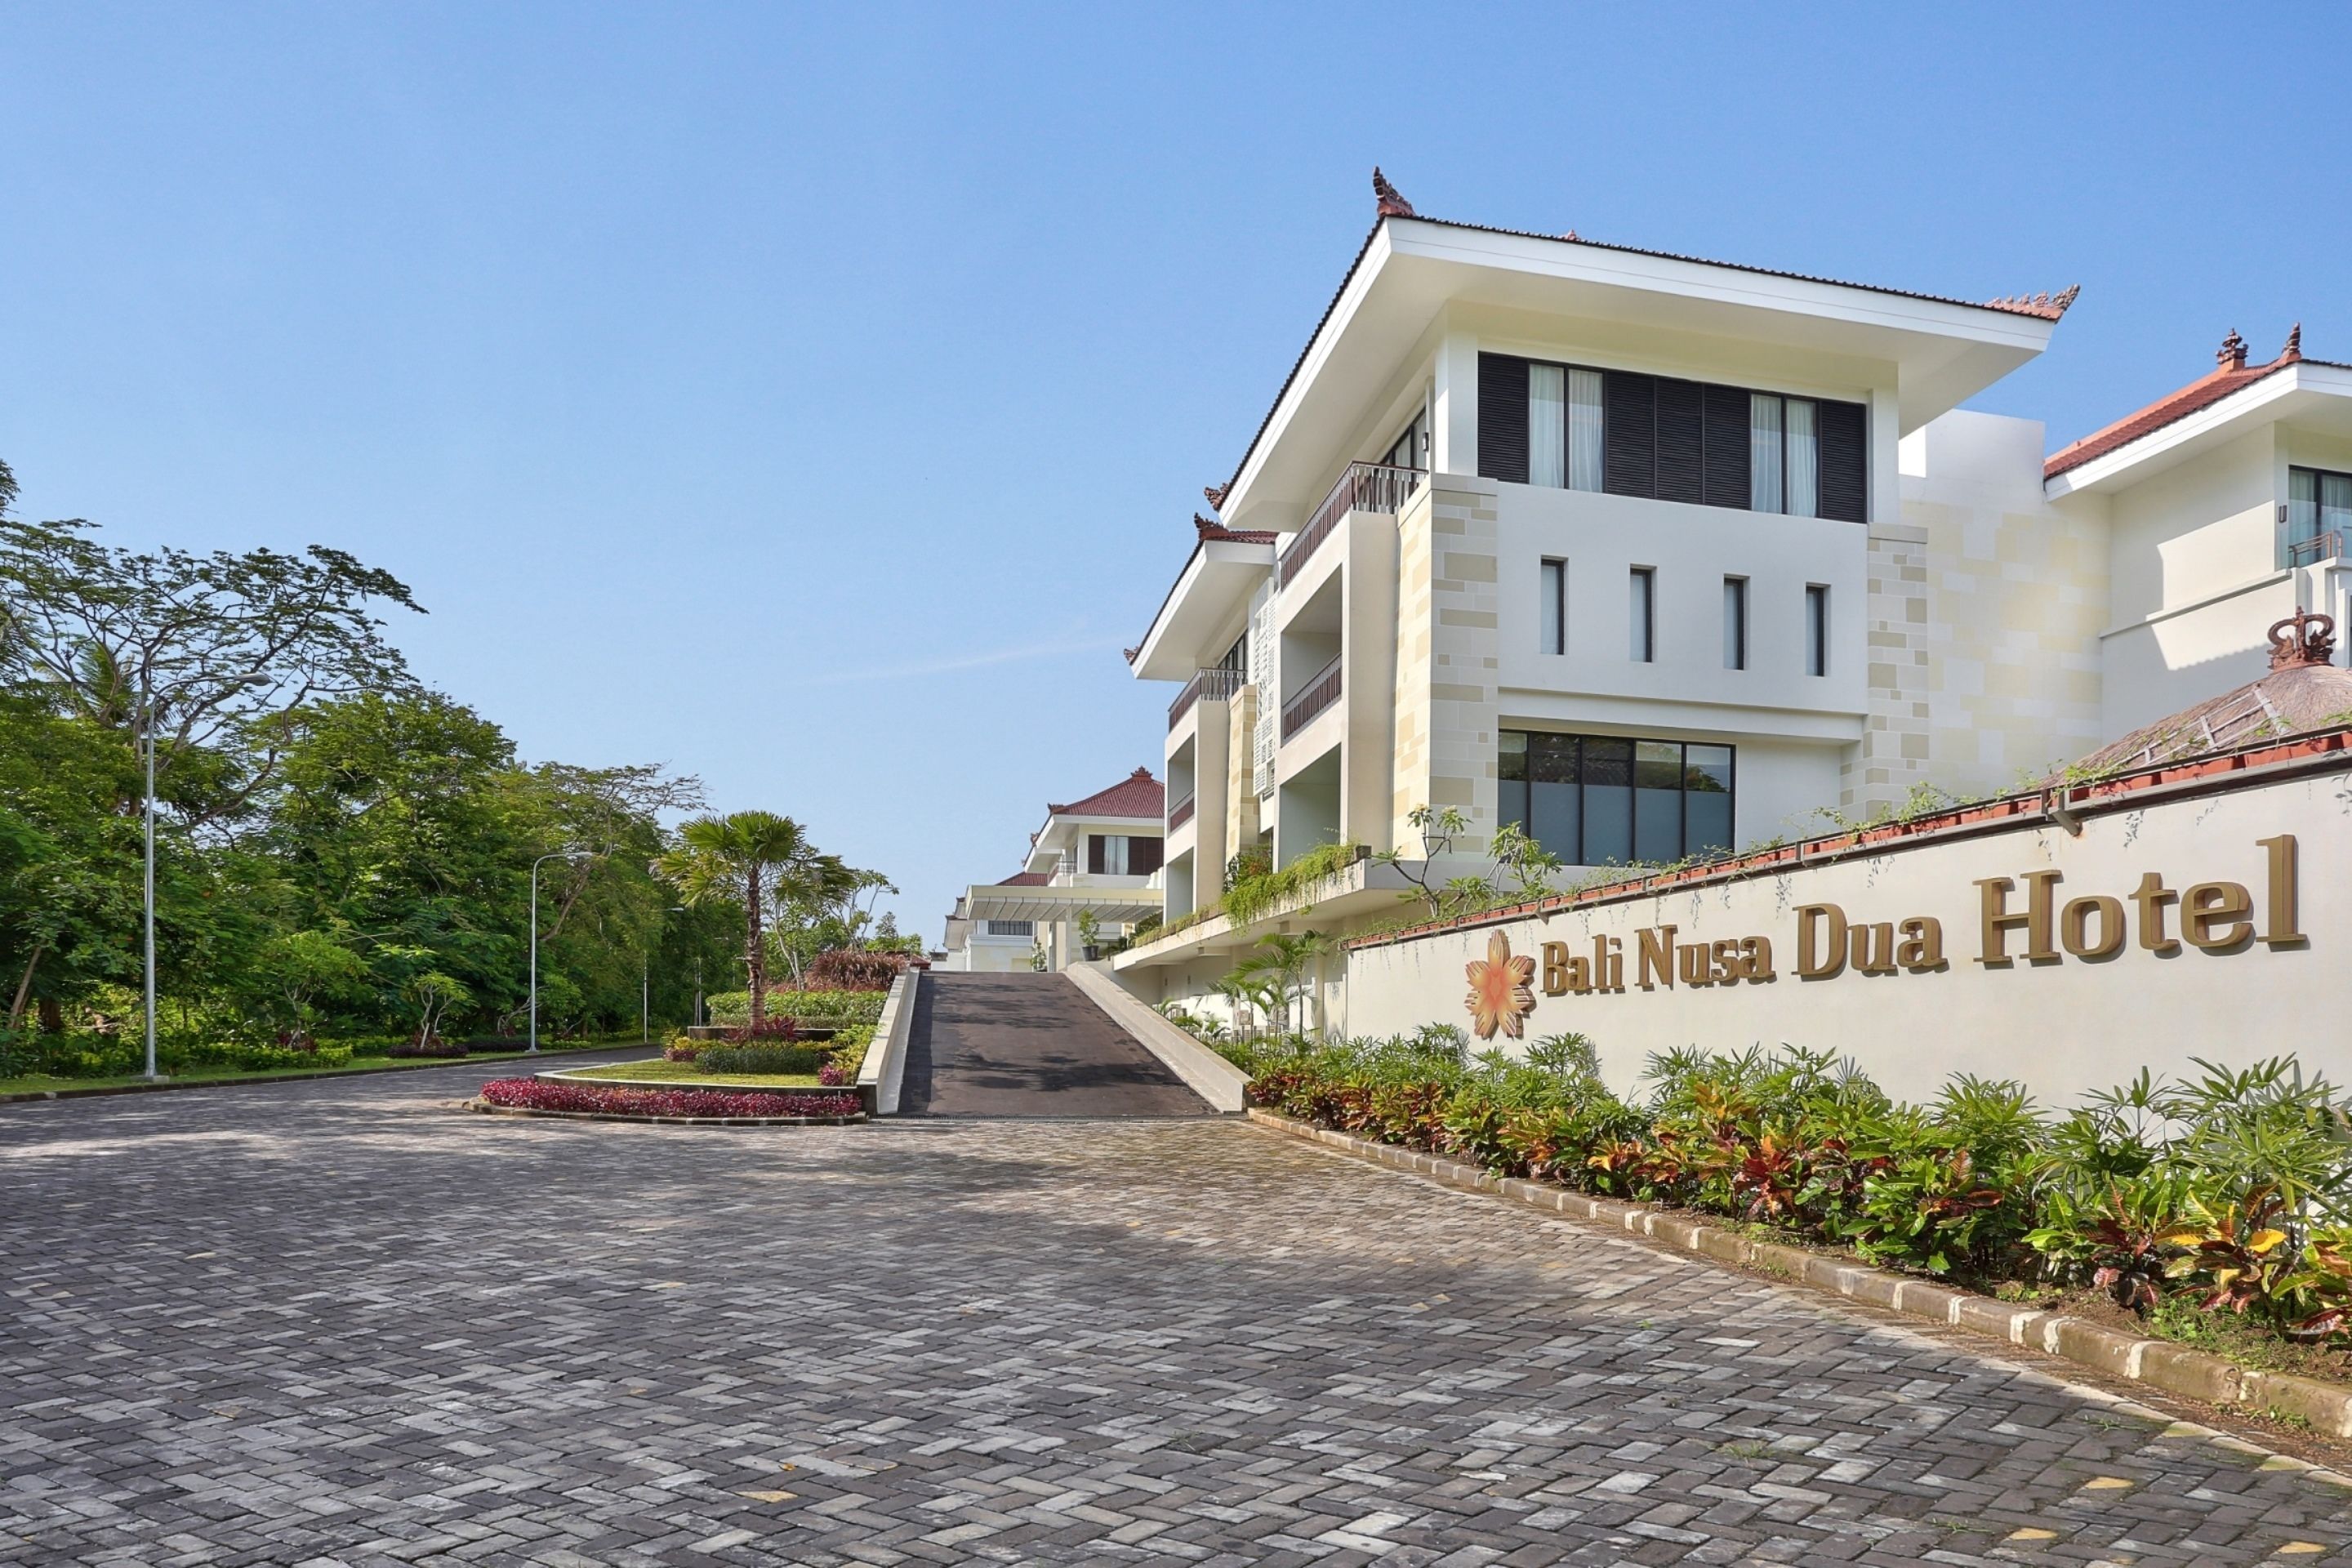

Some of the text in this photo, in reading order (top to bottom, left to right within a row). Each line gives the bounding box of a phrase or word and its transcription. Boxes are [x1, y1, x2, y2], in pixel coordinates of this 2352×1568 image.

[1540, 835, 2307, 994] Bali Nusa Dua Hotel
